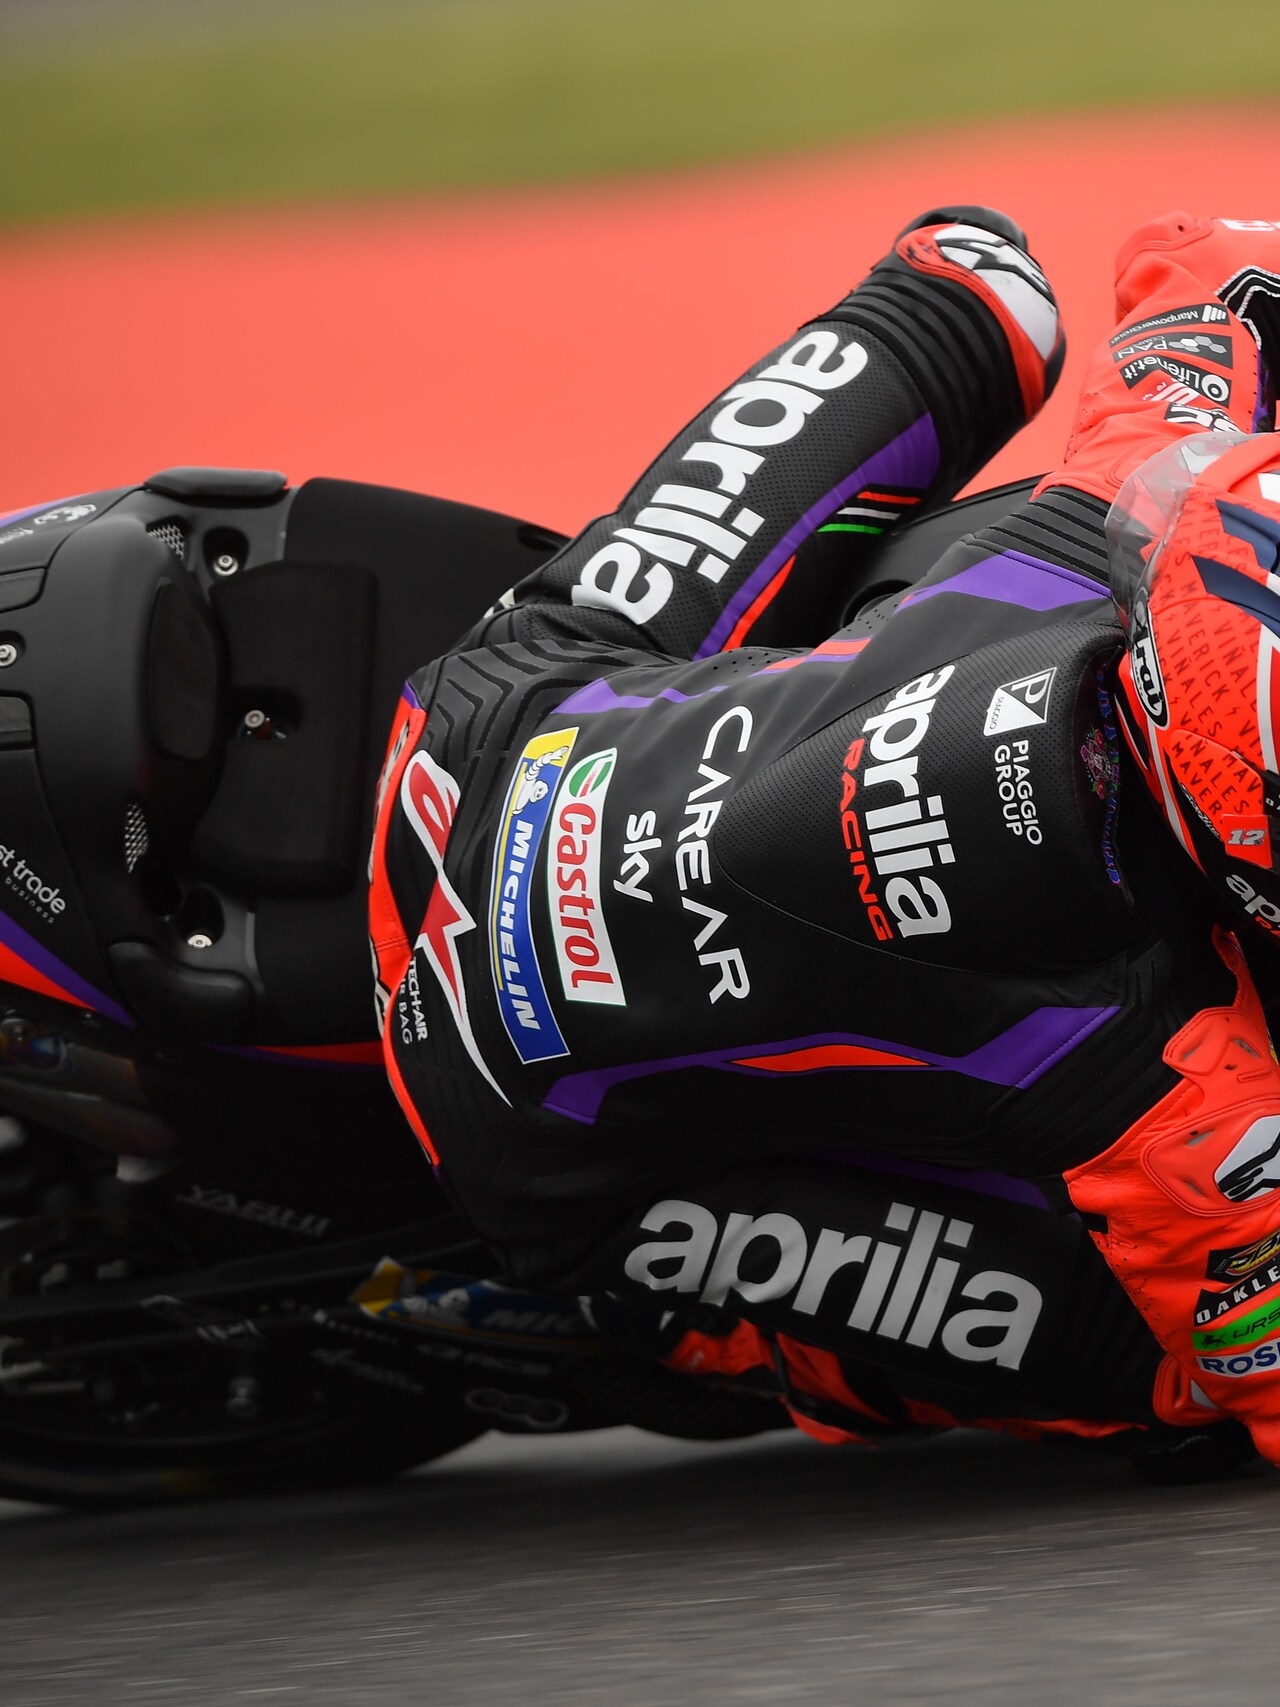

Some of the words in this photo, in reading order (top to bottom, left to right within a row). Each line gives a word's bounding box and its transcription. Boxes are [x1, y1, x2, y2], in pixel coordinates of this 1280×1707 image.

[1124, 356, 1201, 389] Lifenet.it
[571, 330, 869, 626] aprilia
[1167, 628, 1223, 738] VIÑALES
[861, 665, 955, 938] aprilia
[994, 744, 1024, 836] GROUP
[1012, 740, 1043, 845] PIAGGIO
[1172, 741, 1223, 817] MAVER
[13, 859, 66, 914] trade
[613, 811, 661, 902] sky
[675, 705, 754, 1004] CAREAR
[839, 738, 893, 941] RACING
[1228, 829, 1267, 846] 12
[500, 819, 541, 1030] MICHELIN
[556, 801, 615, 990] Castrol
[399, 1001, 413, 1044] BAG
[623, 1199, 1044, 1372] aprilia
